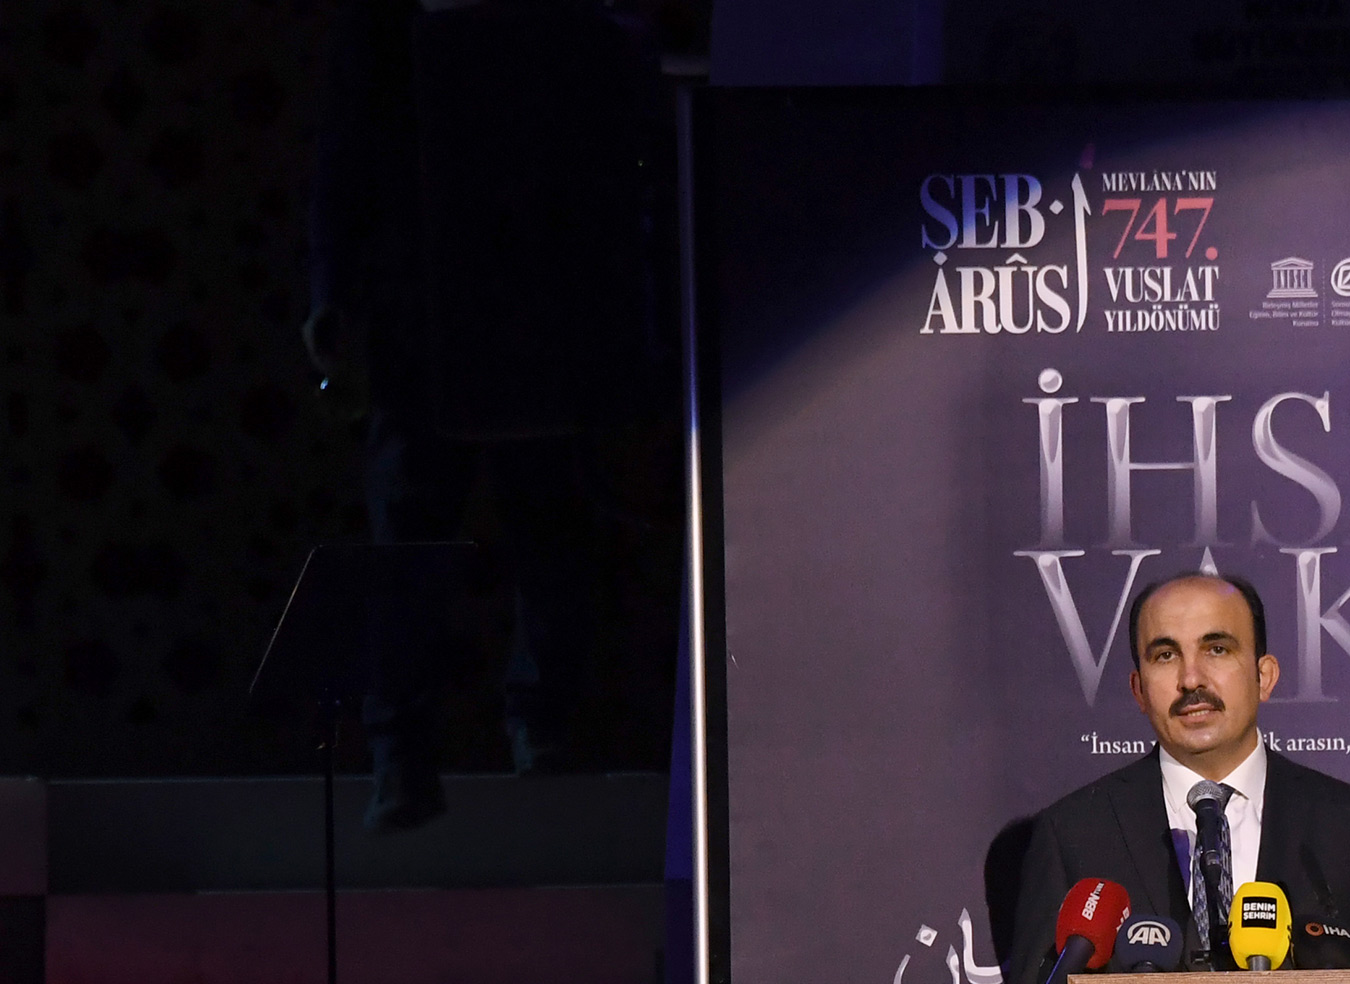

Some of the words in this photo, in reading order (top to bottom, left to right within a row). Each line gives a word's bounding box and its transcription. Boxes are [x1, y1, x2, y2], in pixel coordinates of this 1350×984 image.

[1102, 198, 1218, 259] 747.
[1104, 266, 1219, 302] VUSLAT
[1104, 304, 1220, 332] YILDÖNÜMÜ
[1128, 926, 1168, 947] AA
